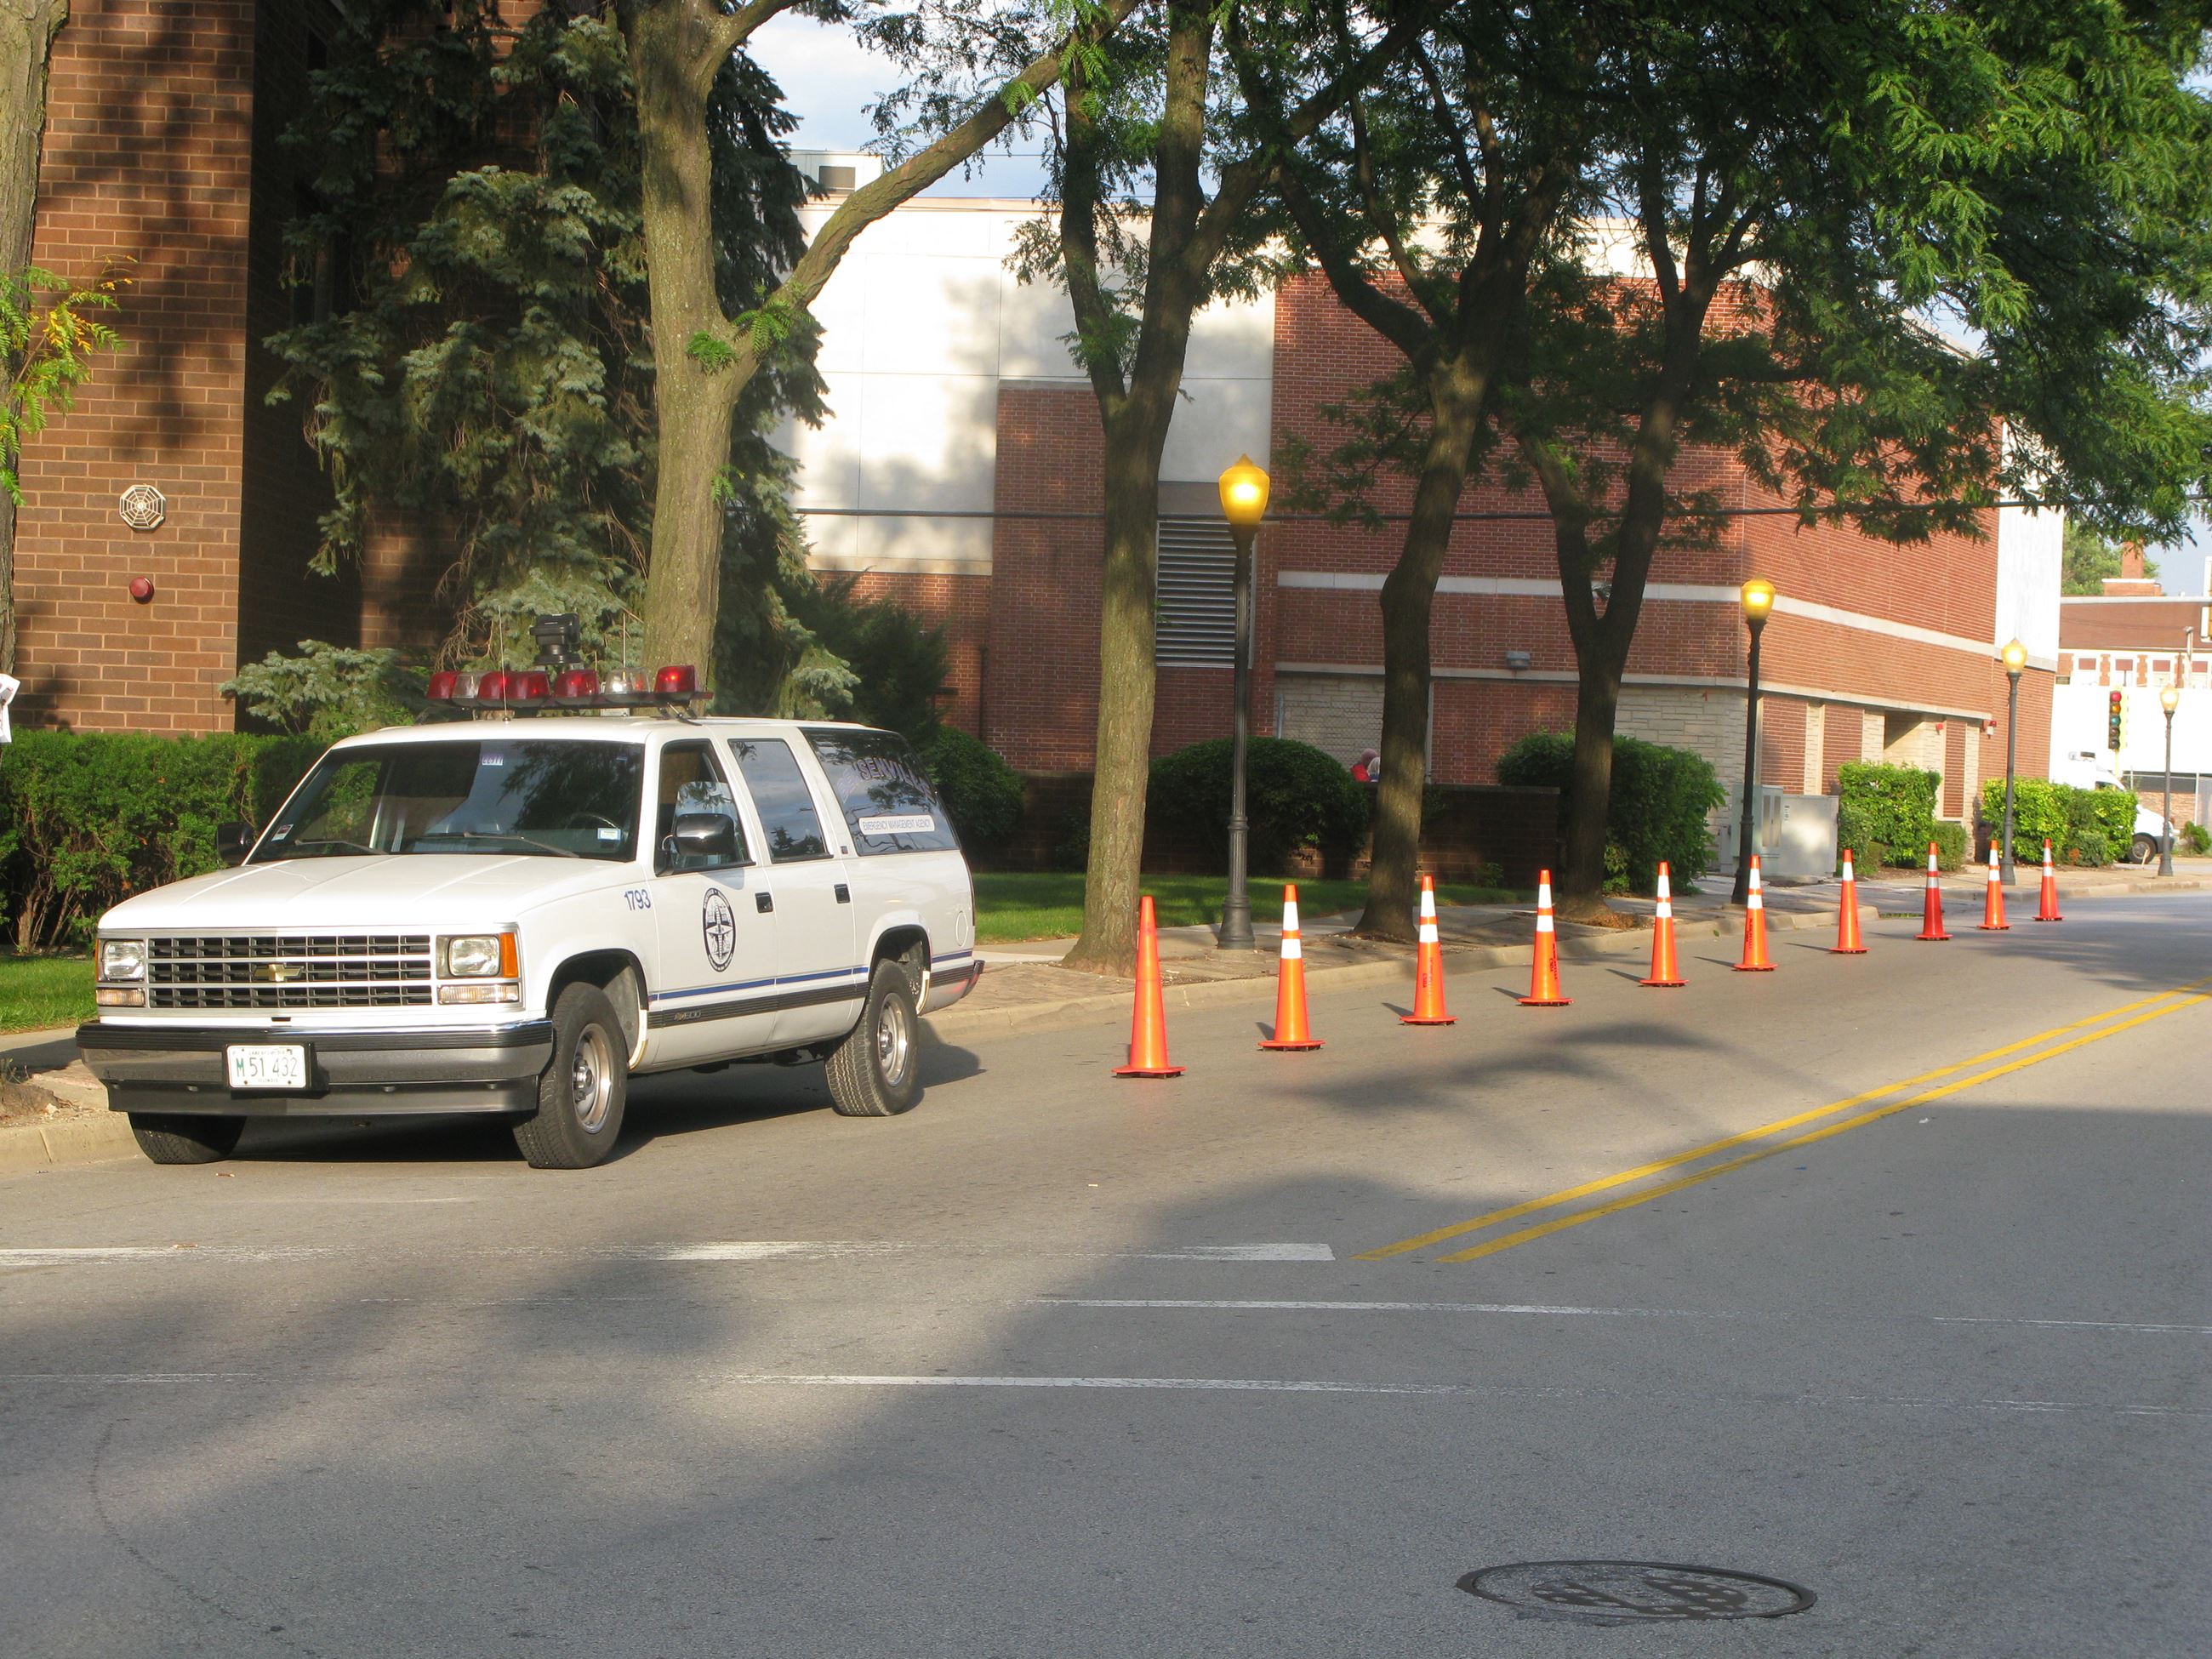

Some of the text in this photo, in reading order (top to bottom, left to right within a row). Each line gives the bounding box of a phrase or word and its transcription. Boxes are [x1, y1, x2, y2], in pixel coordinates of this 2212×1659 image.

[624, 889, 652, 910] 1793
[236, 1058, 298, 1077] M 51 432
